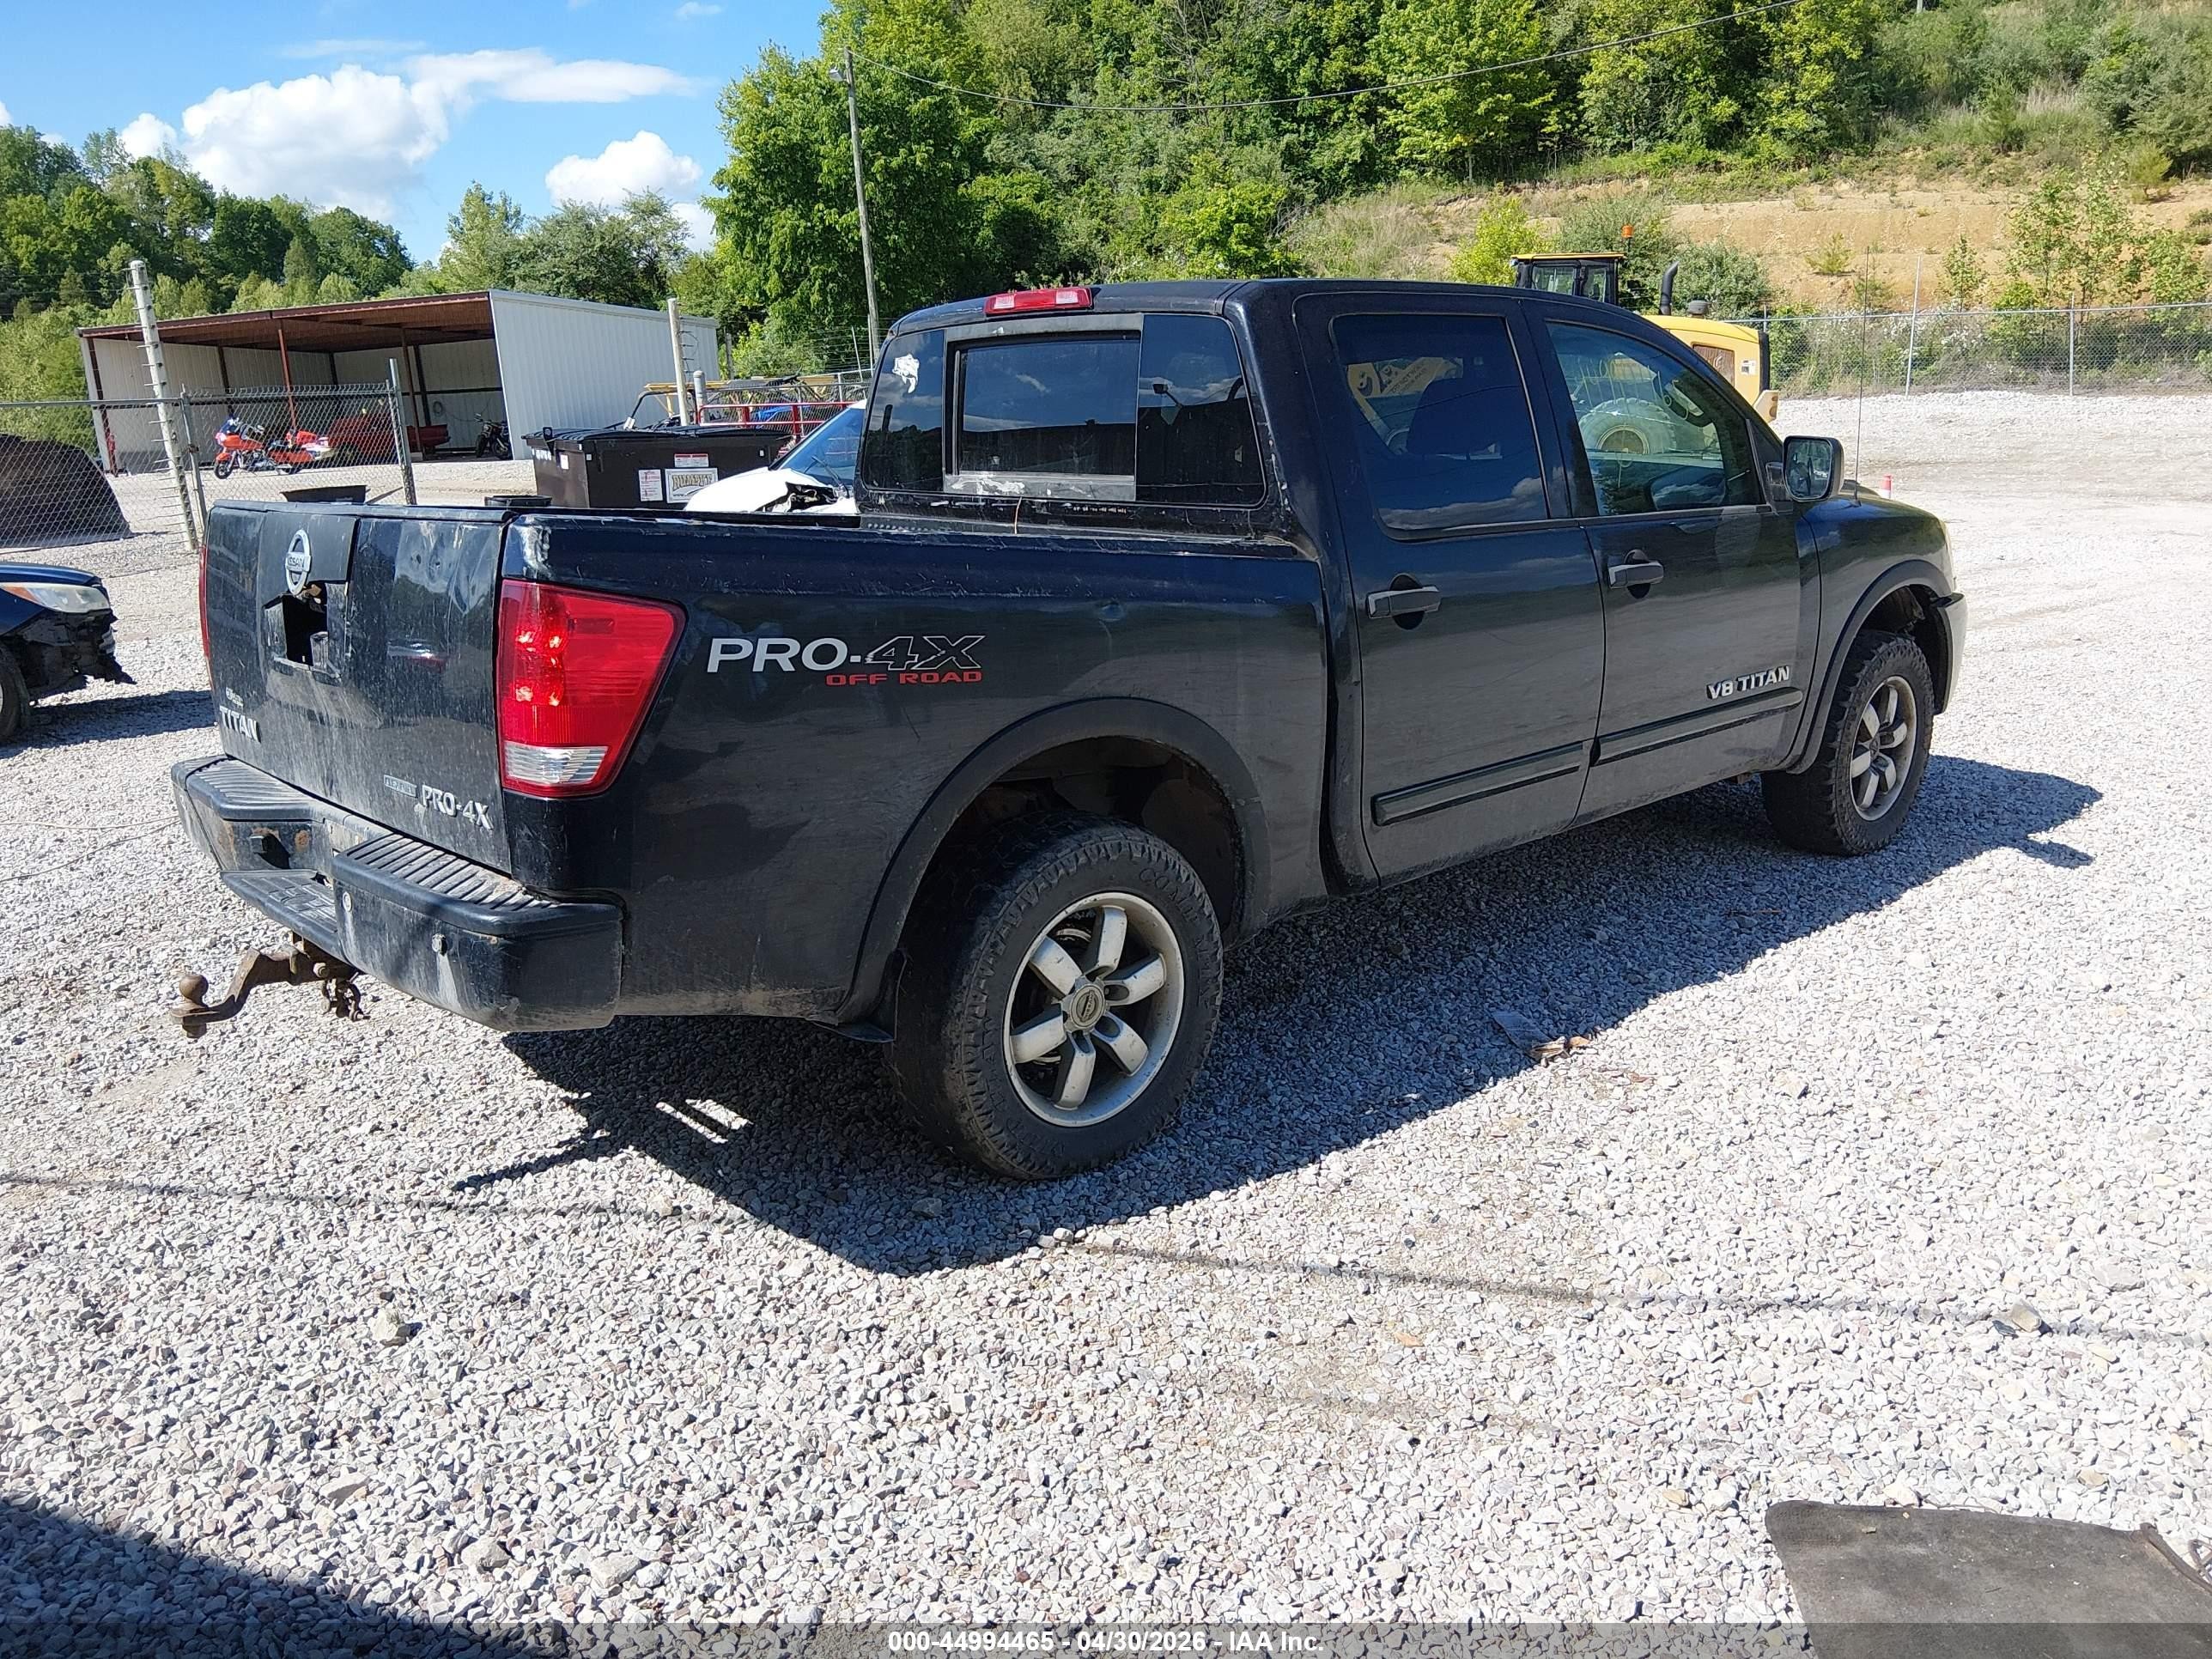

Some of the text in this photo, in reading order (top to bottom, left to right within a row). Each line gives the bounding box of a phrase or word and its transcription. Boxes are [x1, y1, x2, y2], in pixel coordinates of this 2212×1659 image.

[707, 635, 986, 672] PRO-4X
[825, 672, 982, 685] OFF ROAD
[1707, 665, 1790, 700] V8 TITAN
[219, 705, 260, 742] TITAN
[422, 785, 493, 830] PRO-4X
